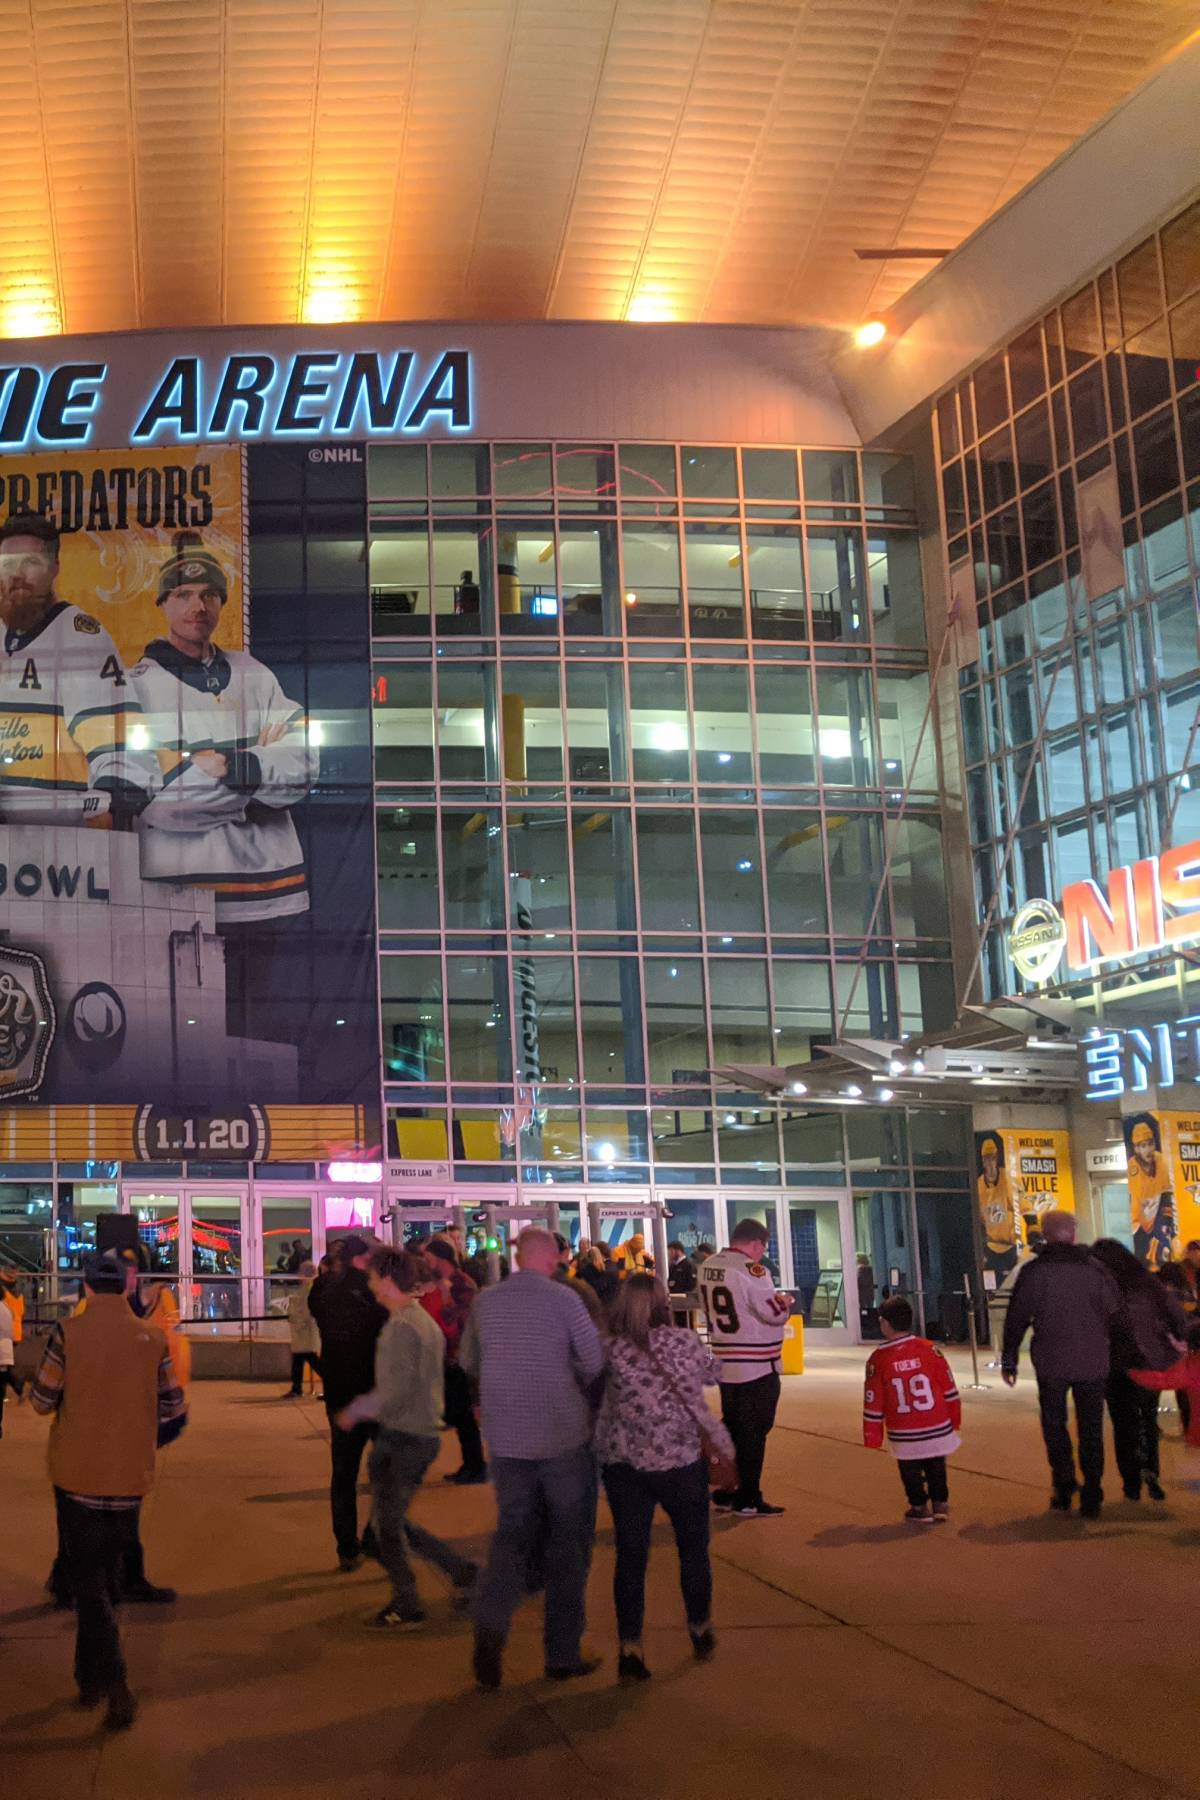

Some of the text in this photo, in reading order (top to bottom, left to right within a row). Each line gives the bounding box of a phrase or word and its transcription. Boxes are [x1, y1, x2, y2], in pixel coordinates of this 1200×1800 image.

[132, 350, 473, 442] ARENA
[19, 658, 42, 690] A
[100, 654, 126, 687] 4
[156, 1119, 249, 1149] 1.1.20
[1019, 1138, 1055, 1148] WELCOME
[391, 1168, 416, 1177] EXPRESS
[418, 1168, 432, 1177] LANE
[1022, 1158, 1056, 1174] SMASH
[1022, 1177, 1058, 1193] VILLE
[892, 1373, 935, 1414] 19
